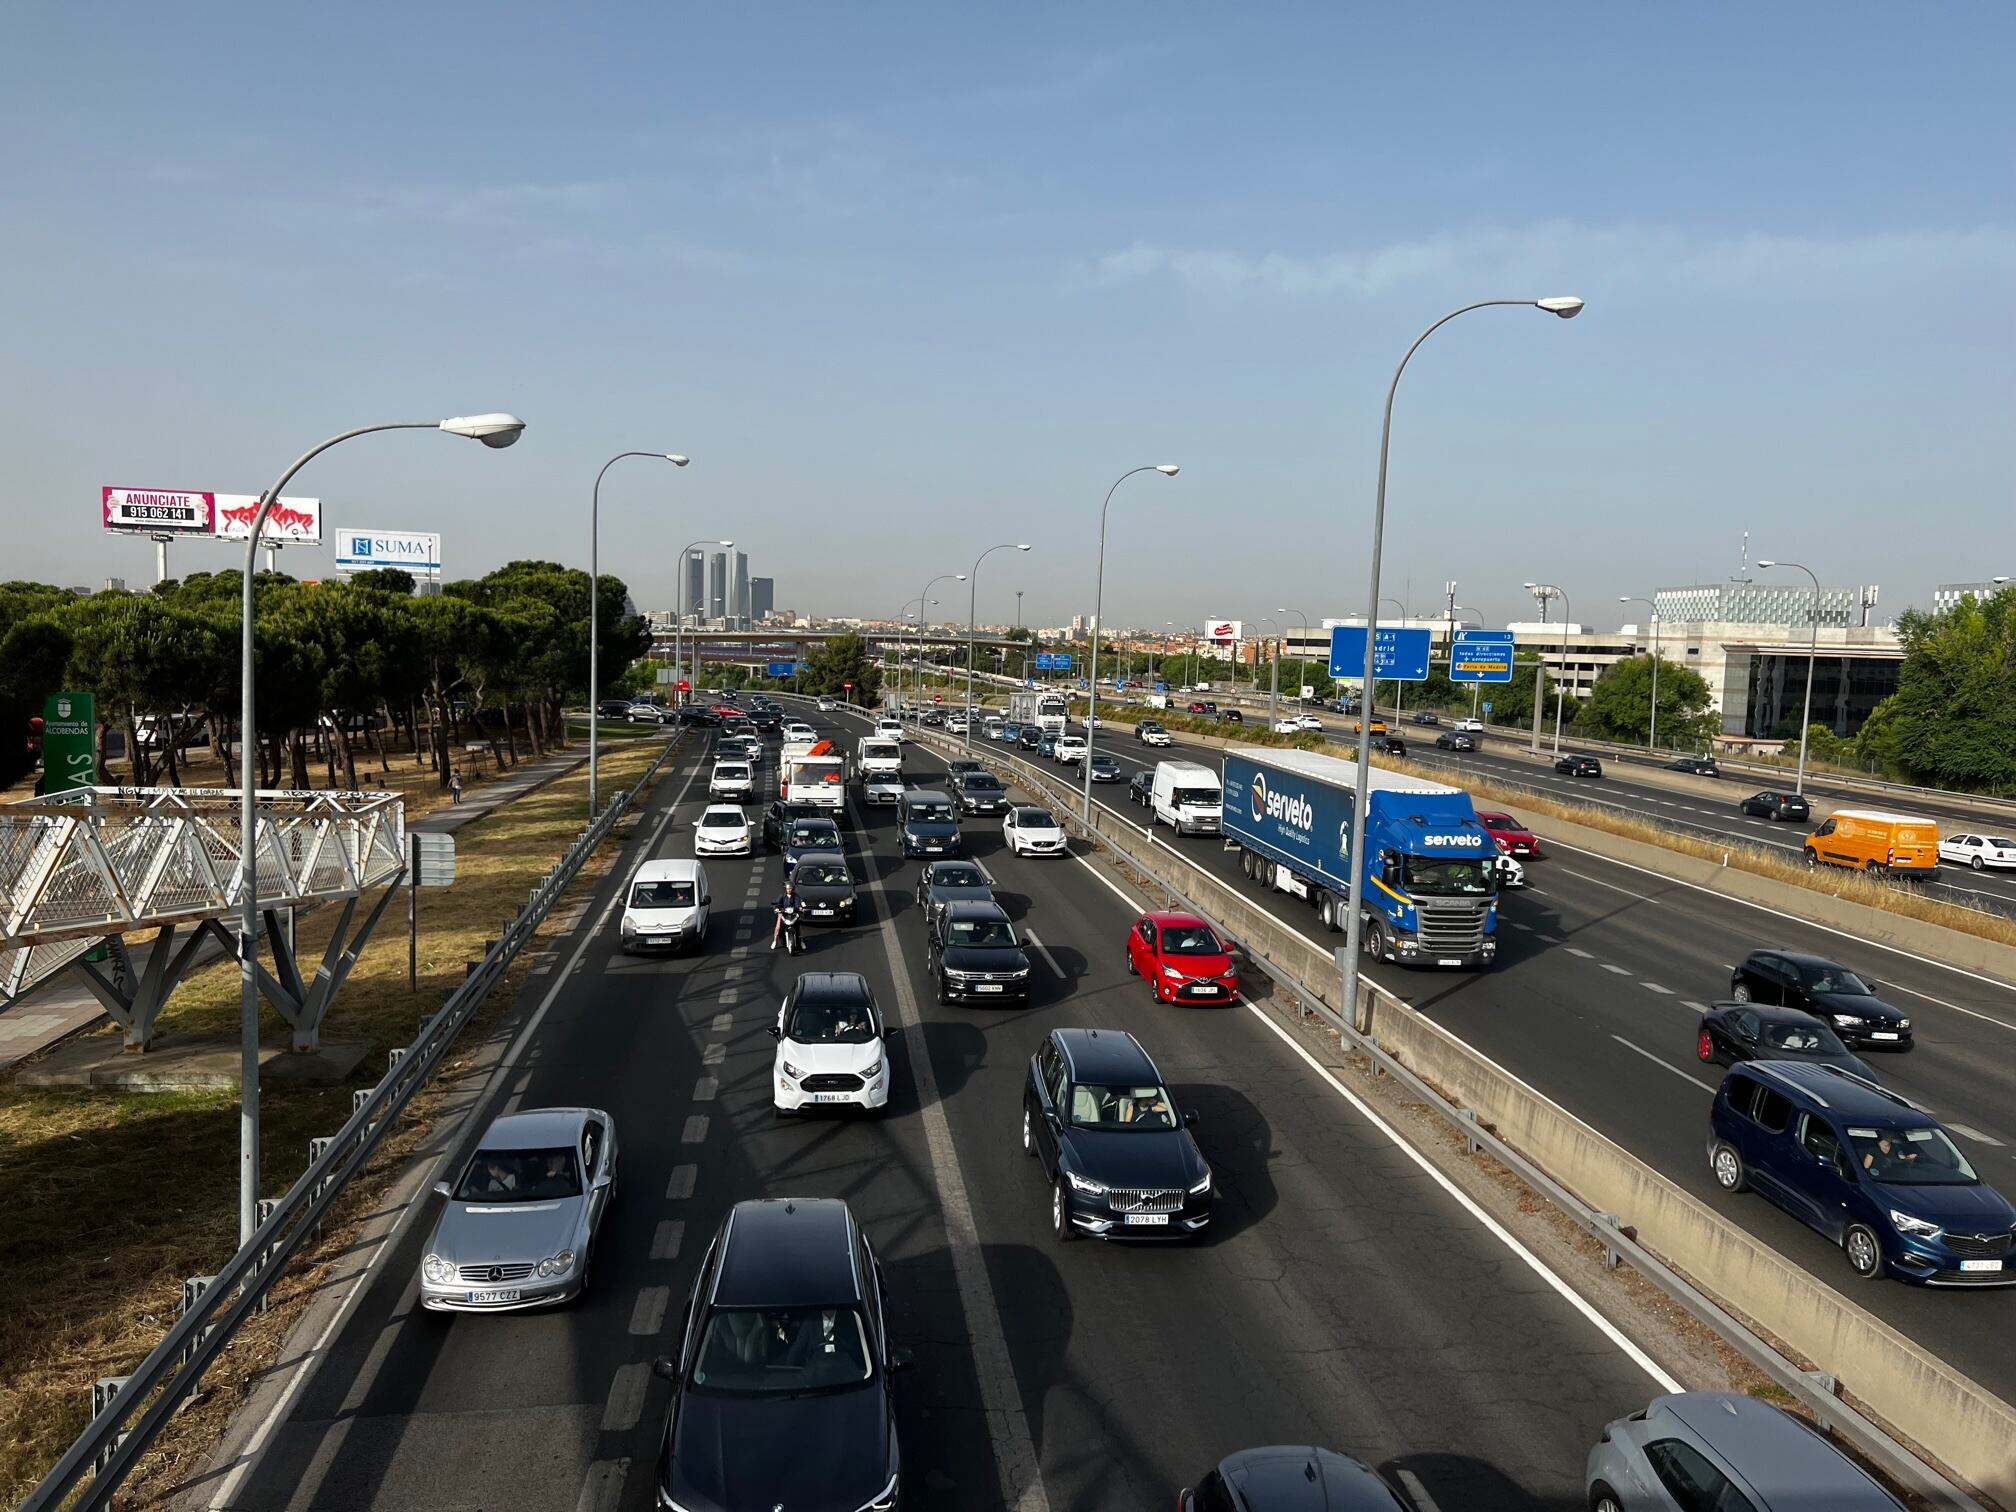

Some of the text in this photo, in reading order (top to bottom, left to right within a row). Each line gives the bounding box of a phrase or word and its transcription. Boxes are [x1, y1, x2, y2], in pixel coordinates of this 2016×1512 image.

[126, 492, 190, 507] ANÚNCIATE
[130, 506, 186, 520] 915 062 141
[375, 539, 424, 554] SUMA
[46, 727, 89, 735] ALCOBENDAS
[1266, 790, 1313, 831] serveto
[1286, 827, 1296, 840] Quality
[1296, 831, 1310, 845] Logistics
[1424, 834, 1482, 847] serveto
[1432, 899, 1472, 907] SCANIA
[1130, 1215, 1167, 1224] 2078 LYH
[473, 1290, 518, 1301] 9577 CZZ
